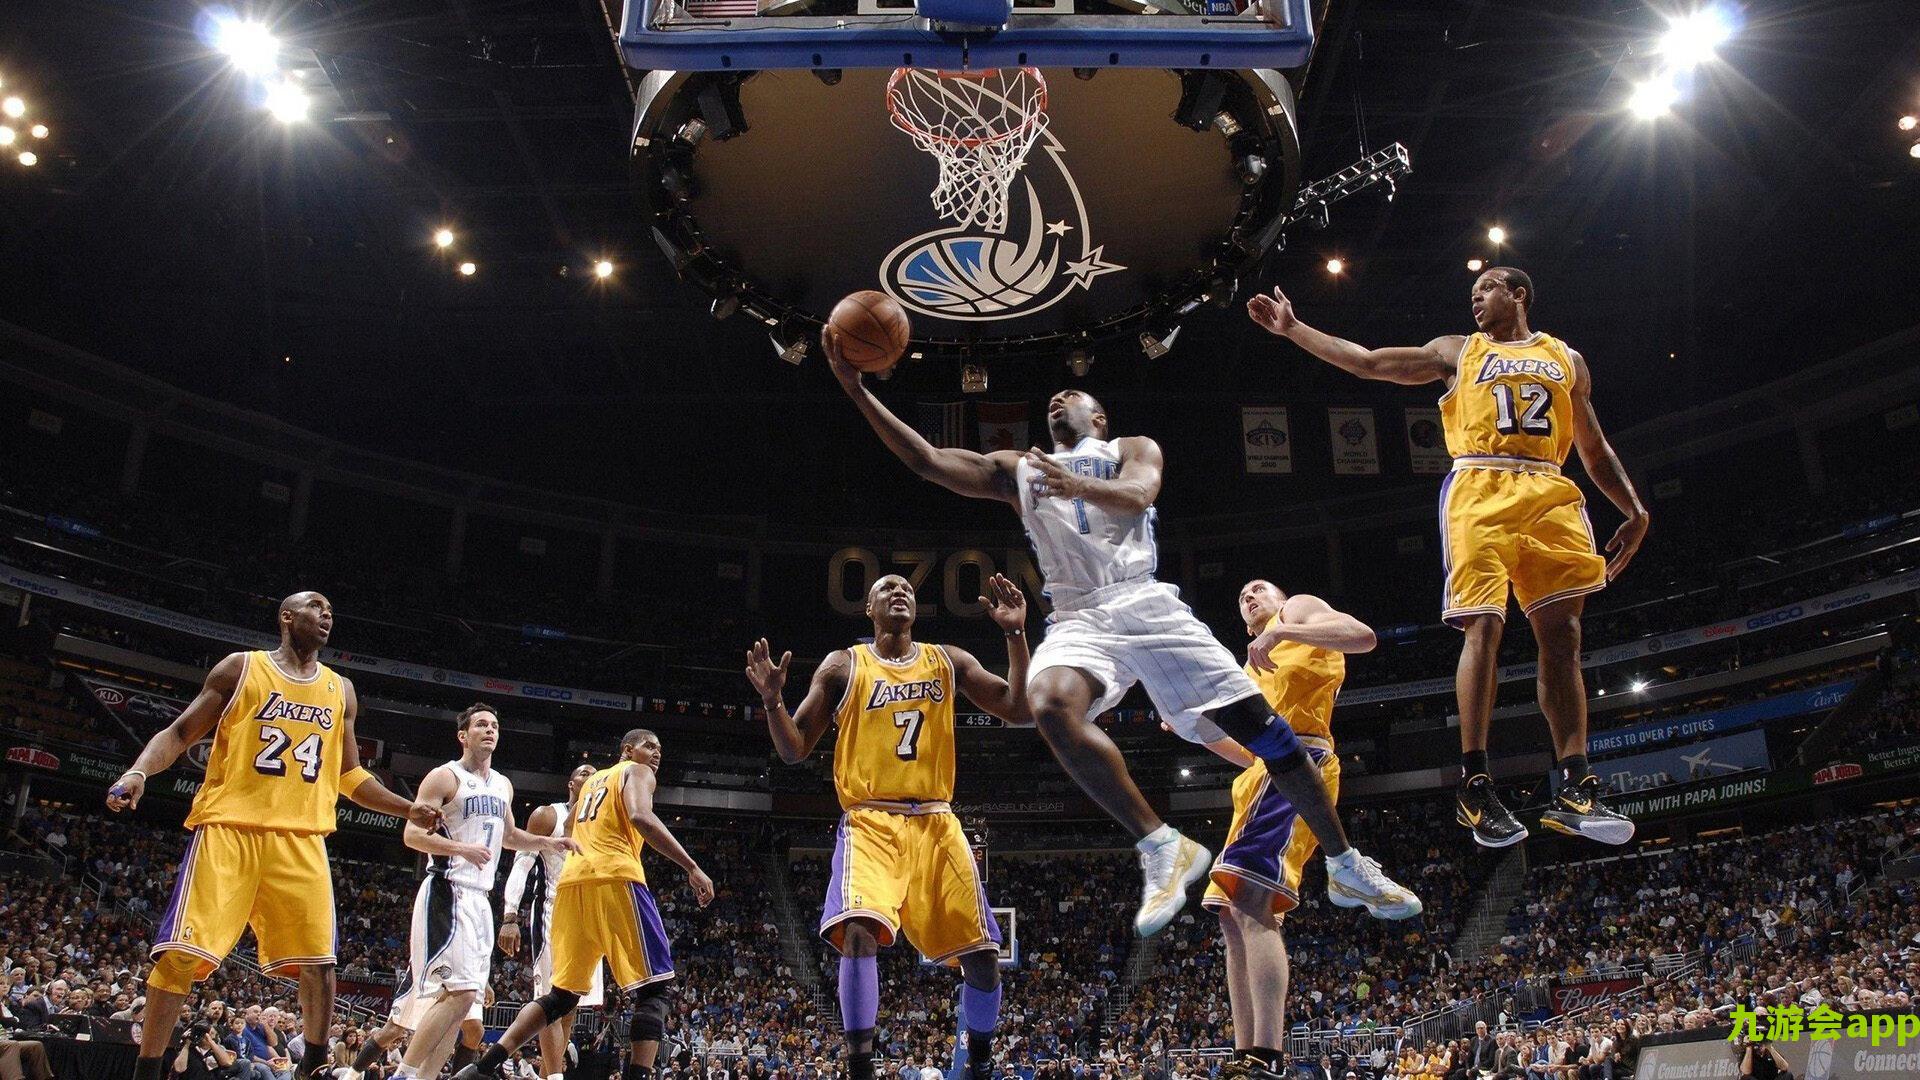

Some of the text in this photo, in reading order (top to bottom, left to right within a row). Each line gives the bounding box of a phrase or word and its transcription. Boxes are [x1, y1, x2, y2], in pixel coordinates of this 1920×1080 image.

[1211, 2, 1233, 12] NBA
[1475, 353, 1566, 384] LAKERS
[1492, 383, 1552, 436] 12
[1071, 498, 1090, 534] 1
[1747, 607, 1803, 630] GEICO
[1505, 664, 1537, 678] Amway
[99, 689, 119, 702] KIA
[522, 684, 573, 700] GEICO
[588, 697, 627, 709] PEPSICO
[866, 678, 947, 711] LAKERS
[254, 692, 333, 729] LAKERS
[966, 715, 992, 726] 4:52
[893, 709, 921, 761] 7
[1593, 735, 1622, 751] FARES
[1625, 732, 1636, 746] TO
[1640, 728, 1665, 743] OVER
[1682, 719, 1715, 735] CITIES
[254, 727, 322, 783] 24
[577, 787, 608, 822] 17
[1619, 779, 1767, 815] WIN WITH PAPA JOHNS!
[355, 812, 400, 829] JOHNS!
[483, 822, 495, 848] 7
